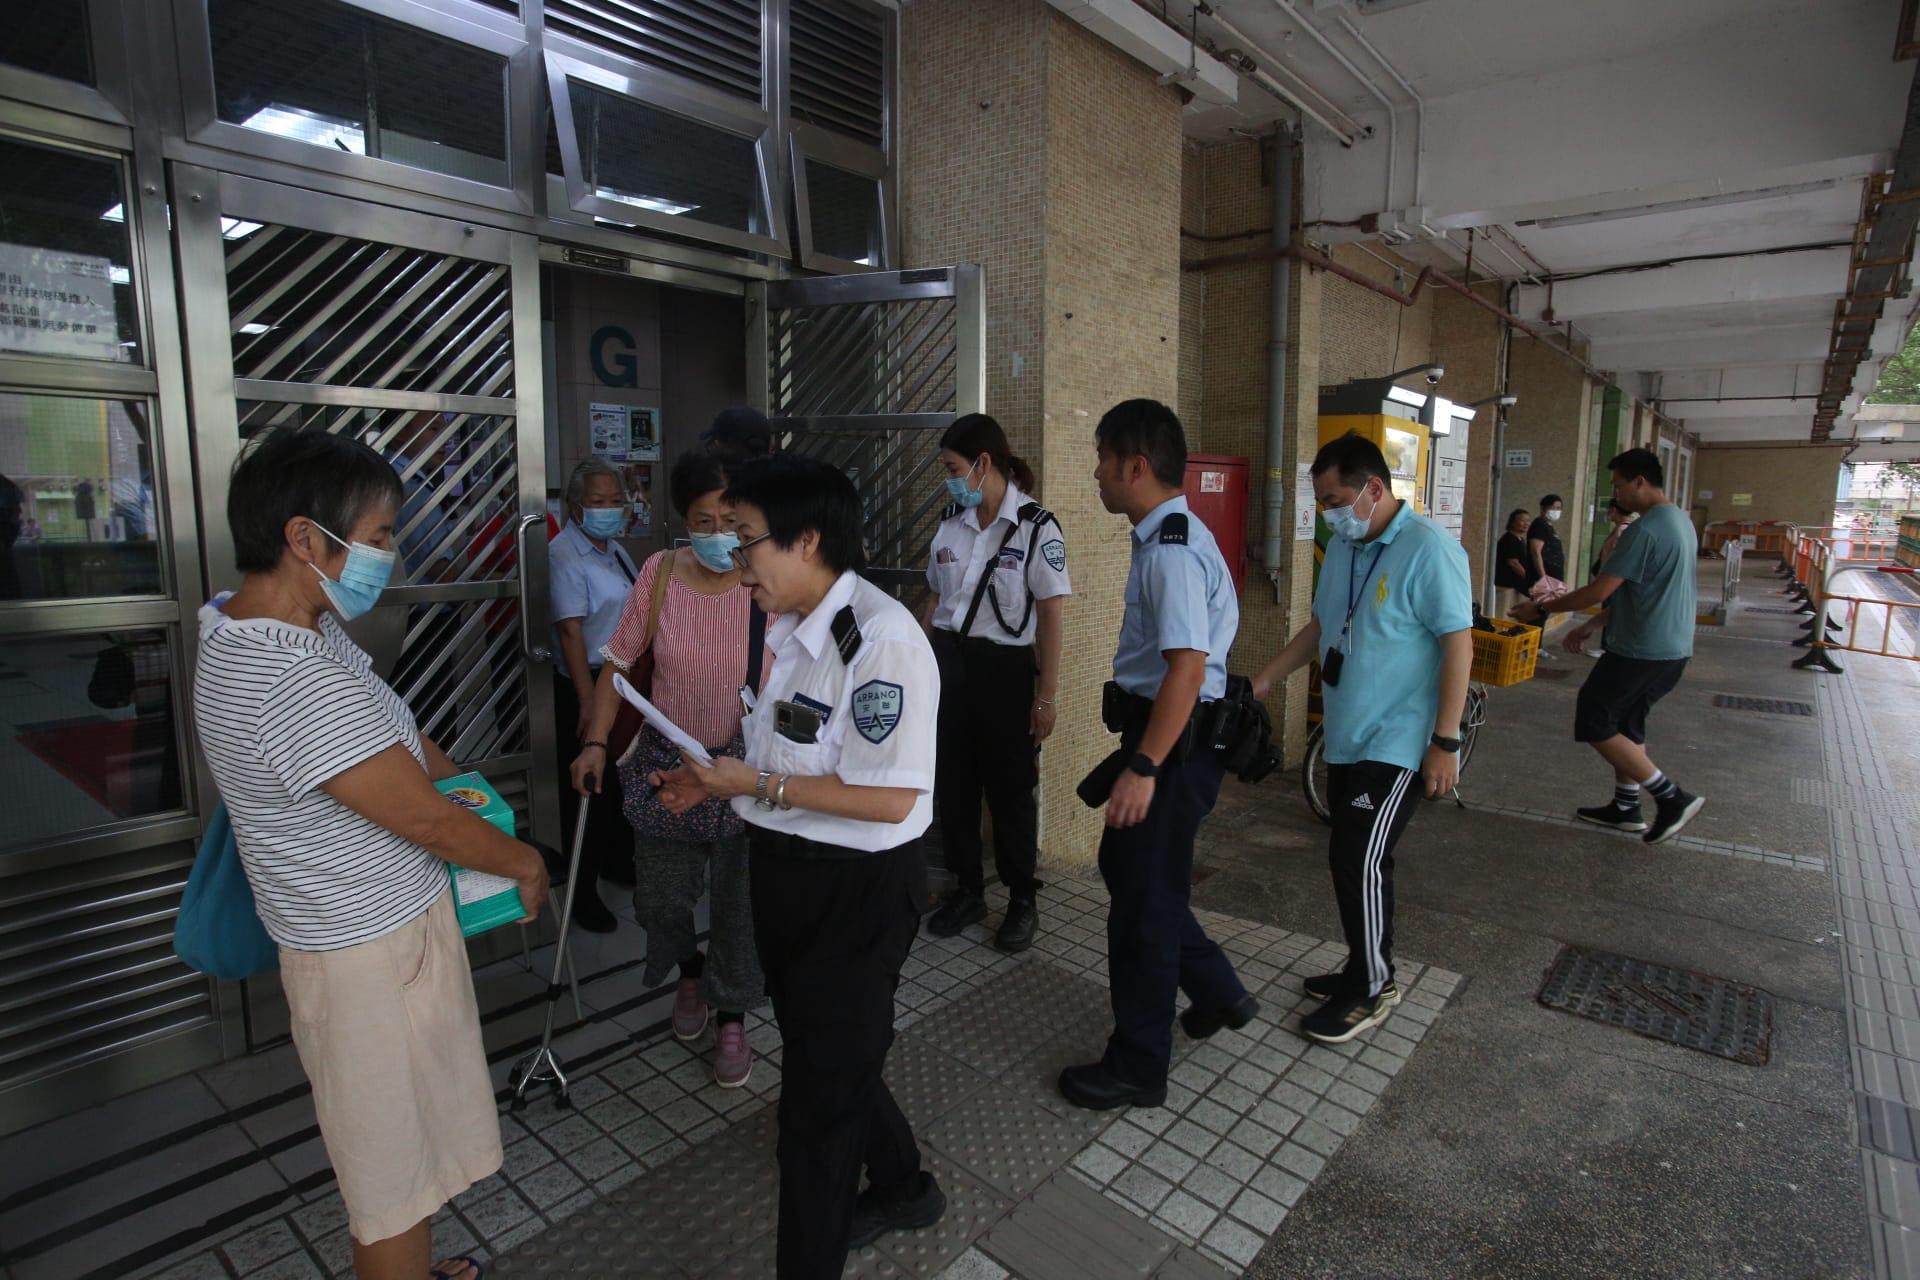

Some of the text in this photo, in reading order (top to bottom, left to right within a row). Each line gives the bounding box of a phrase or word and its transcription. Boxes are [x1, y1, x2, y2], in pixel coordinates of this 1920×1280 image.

[590, 325, 638, 388] G
[857, 690, 897, 703] ARRANO
[1351, 801, 1374, 810] adidas
